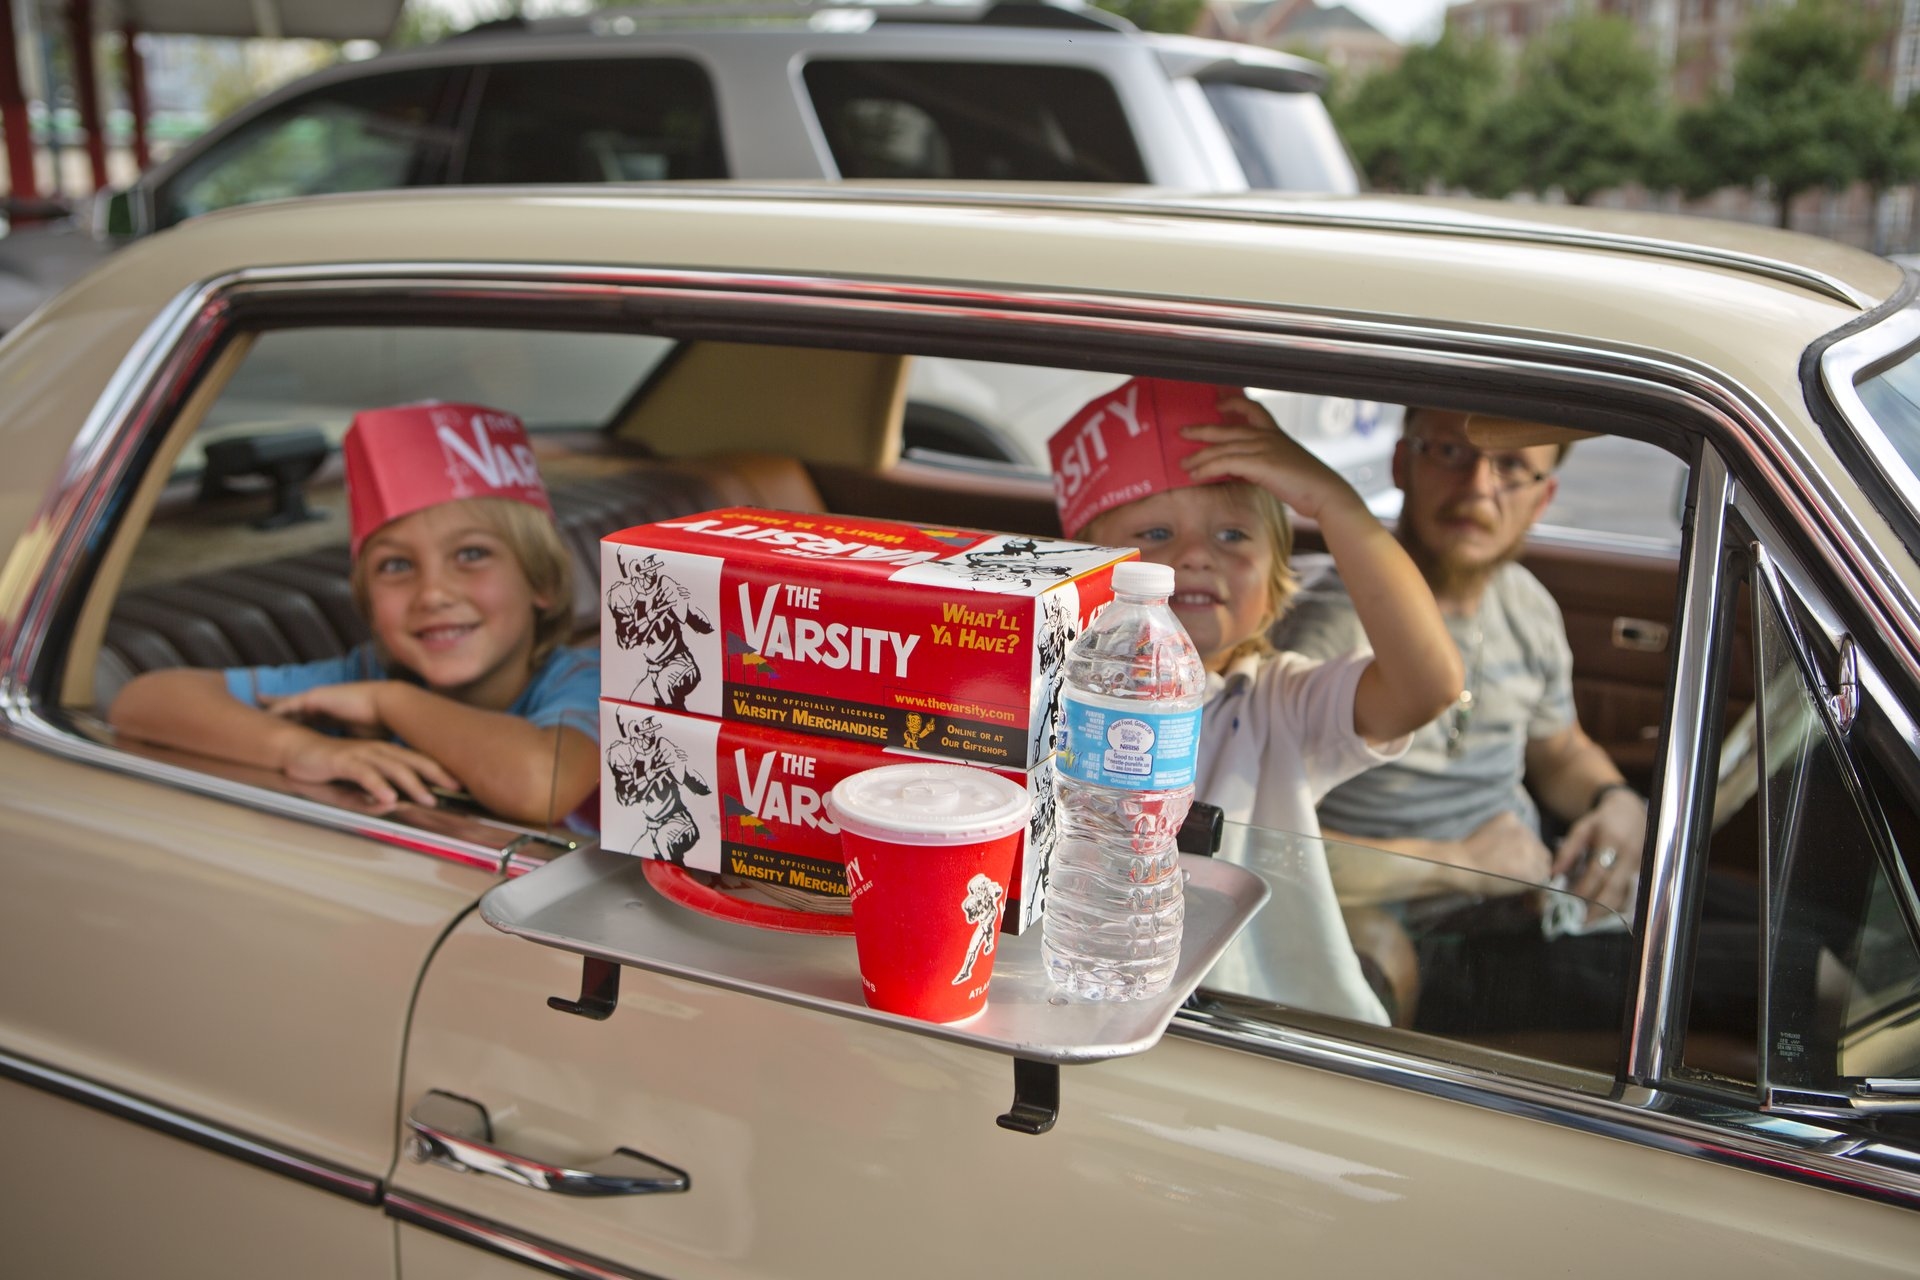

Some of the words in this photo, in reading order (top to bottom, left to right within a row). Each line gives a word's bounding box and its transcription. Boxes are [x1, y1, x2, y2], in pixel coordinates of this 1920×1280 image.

[655, 519, 940, 566] VARSITY
[785, 584, 821, 611] THE
[738, 581, 921, 679] VARSITY
[942, 602, 1020, 631] WHAT'LL
[930, 624, 952, 646] YA
[958, 628, 1020, 654] HAVE?
[733, 690, 750, 699] BUY
[756, 694, 777, 703] ONLY
[783, 698, 836, 712] OFFICIALLY
[841, 707, 886, 720] LICENSED
[894, 694, 1015, 722] www.thevarsity.com
[733, 699, 787, 722] VARSITY
[792, 708, 889, 740] MERCHANDISE
[947, 724, 977, 738] ONLINE
[980, 731, 991, 740] OR
[994, 734, 1004, 743] AT
[941, 737, 959, 748] OUR
[962, 740, 1008, 757] GIFTSHOPS
[780, 752, 817, 779] THE
[731, 850, 748, 858] BUY
[753, 854, 775, 863] ONLY
[780, 859, 832, 875] OFFICIALLY
[731, 858, 785, 883] VARSITY
